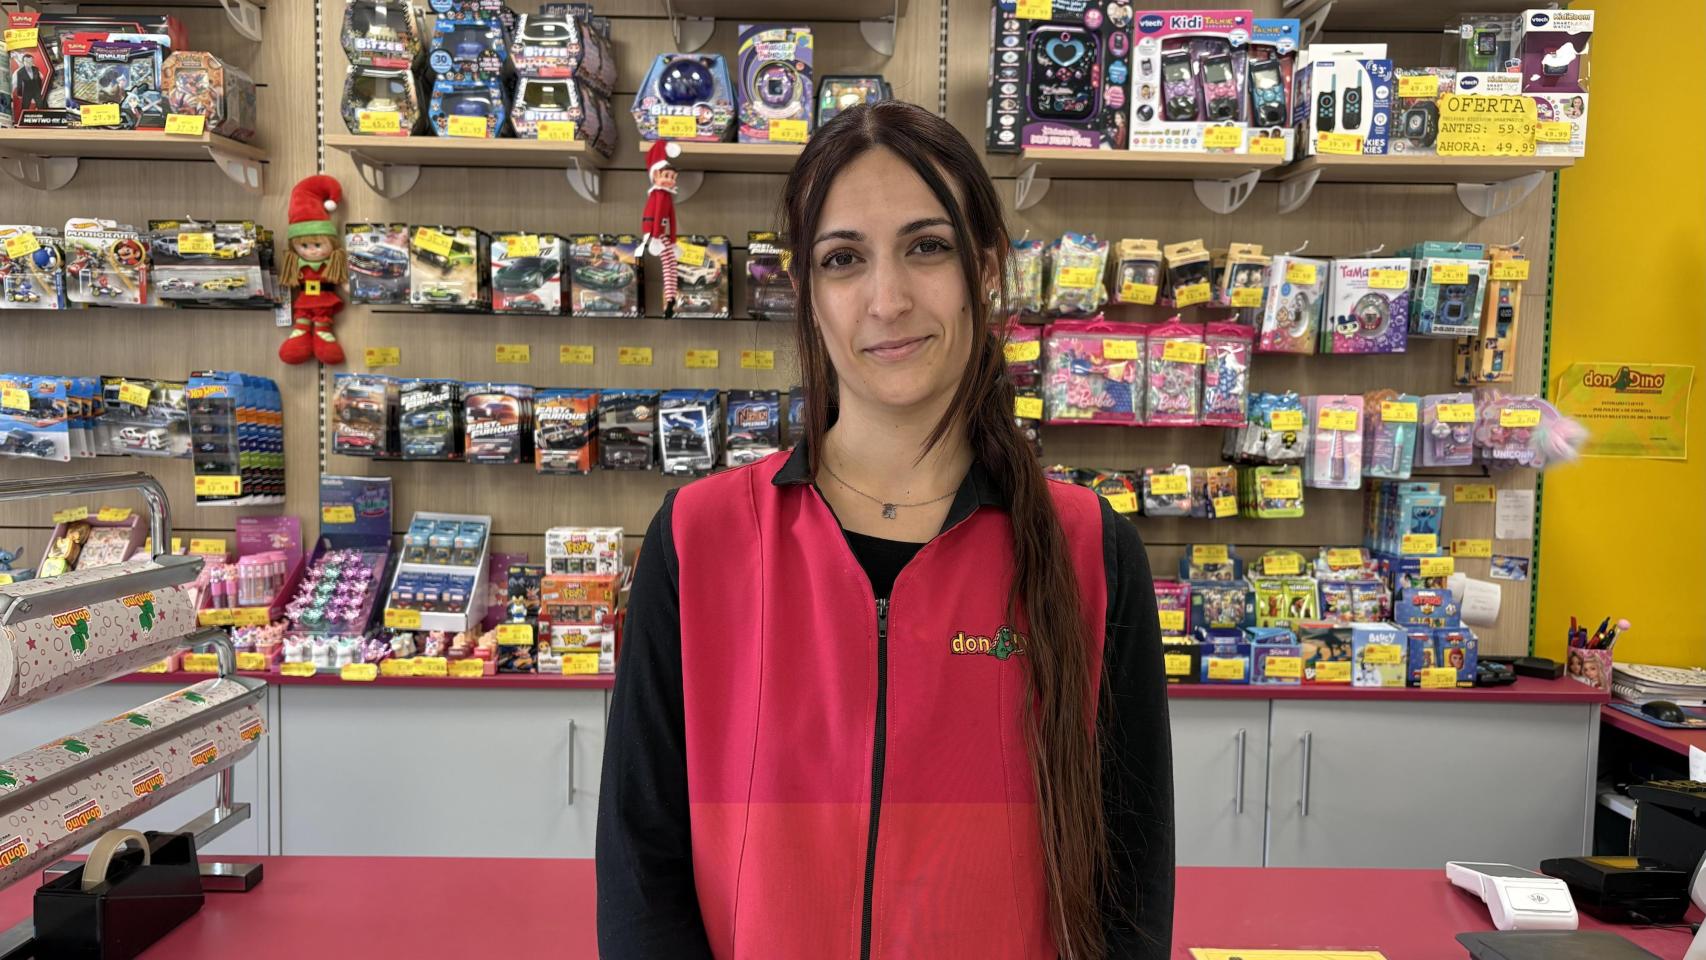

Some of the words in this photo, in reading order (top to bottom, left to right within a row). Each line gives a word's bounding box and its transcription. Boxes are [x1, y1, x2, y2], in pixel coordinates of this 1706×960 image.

[1139, 19, 1163, 28] vtech
[1171, 15, 1202, 29] Kidi
[435, 56, 447, 65] 30
[1448, 97, 1525, 113] OFERTA
[1441, 123, 1487, 134] ANTES:
[1438, 142, 1486, 152] AHORA:
[1496, 142, 1536, 152] 49.99
[1584, 370, 1612, 387] don
[1492, 448, 1535, 458] UNICORN
[53, 608, 91, 628] donDino
[951, 632, 990, 653] don
[133, 773, 165, 796] donDino
[66, 804, 102, 832] donDino
